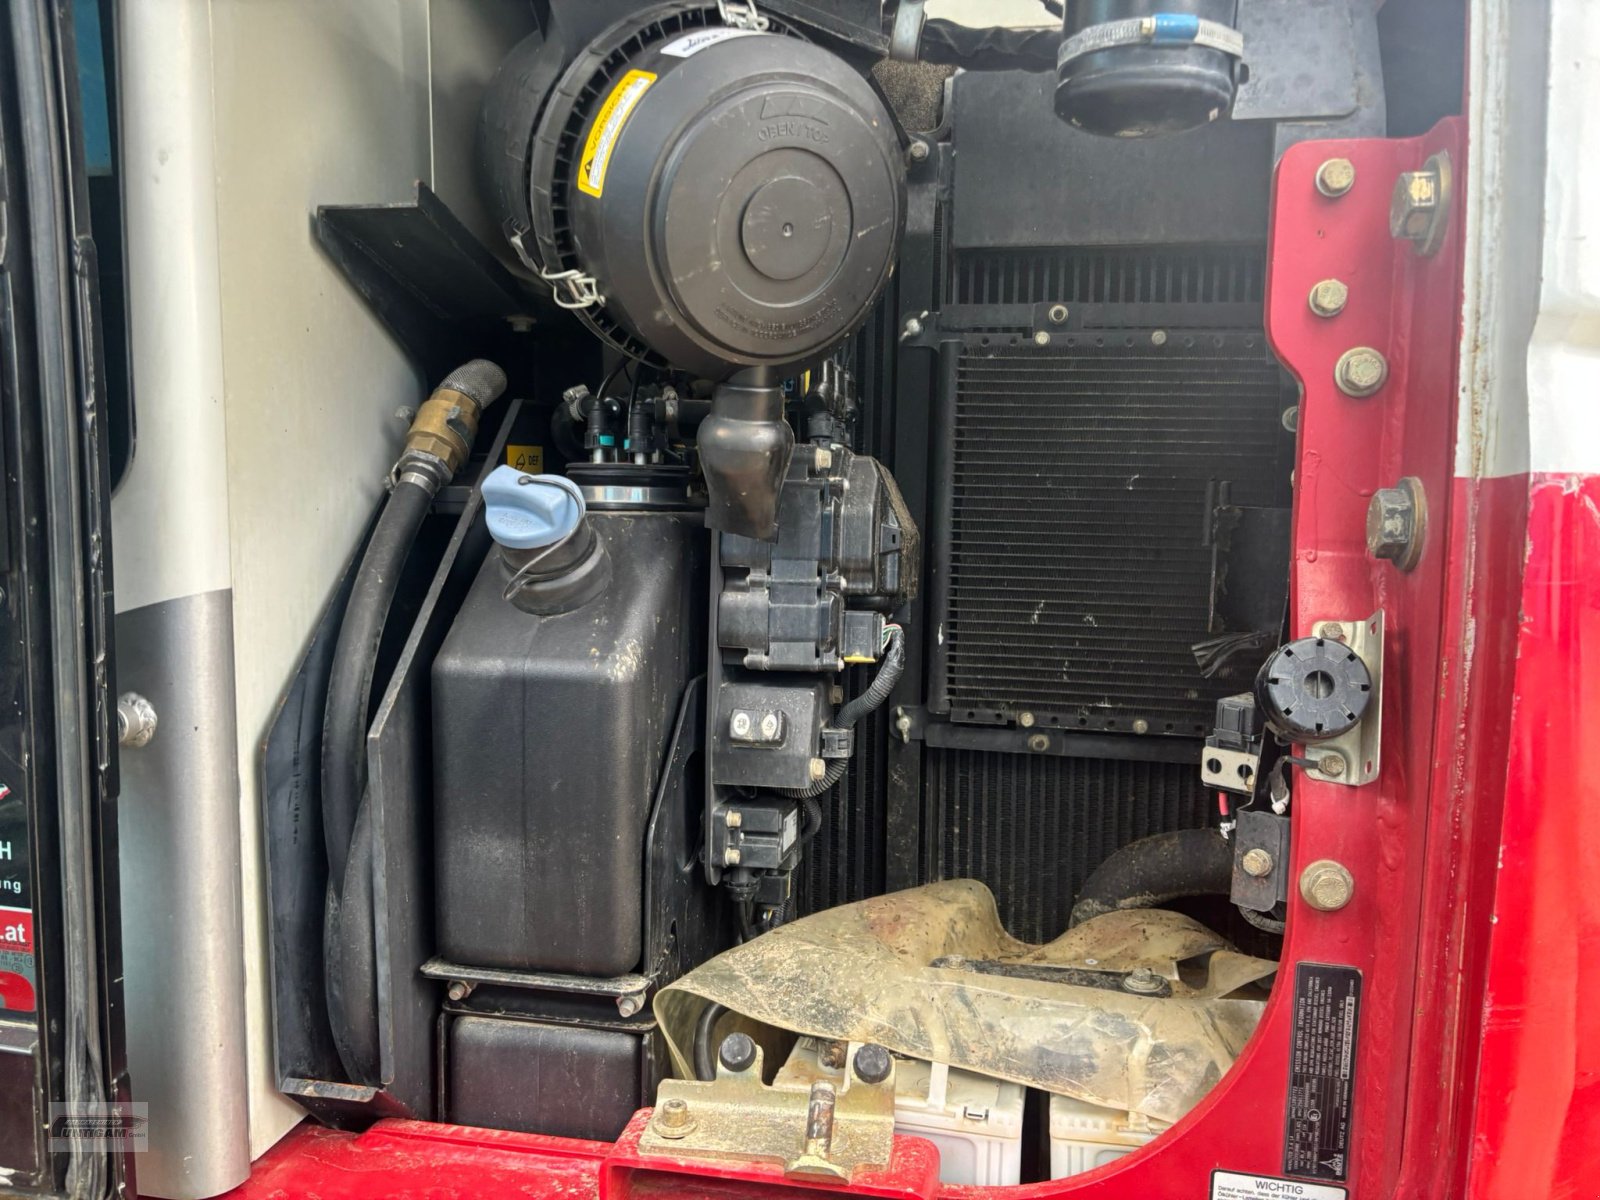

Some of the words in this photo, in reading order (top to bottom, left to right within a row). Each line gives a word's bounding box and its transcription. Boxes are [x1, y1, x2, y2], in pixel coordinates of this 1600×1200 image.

[528, 455, 540, 466] DEF
[1297, 998, 1305, 1027] INFORMATION
[1340, 1122, 1345, 1130] AG
[1255, 1180, 1304, 1195] WICHTIG
